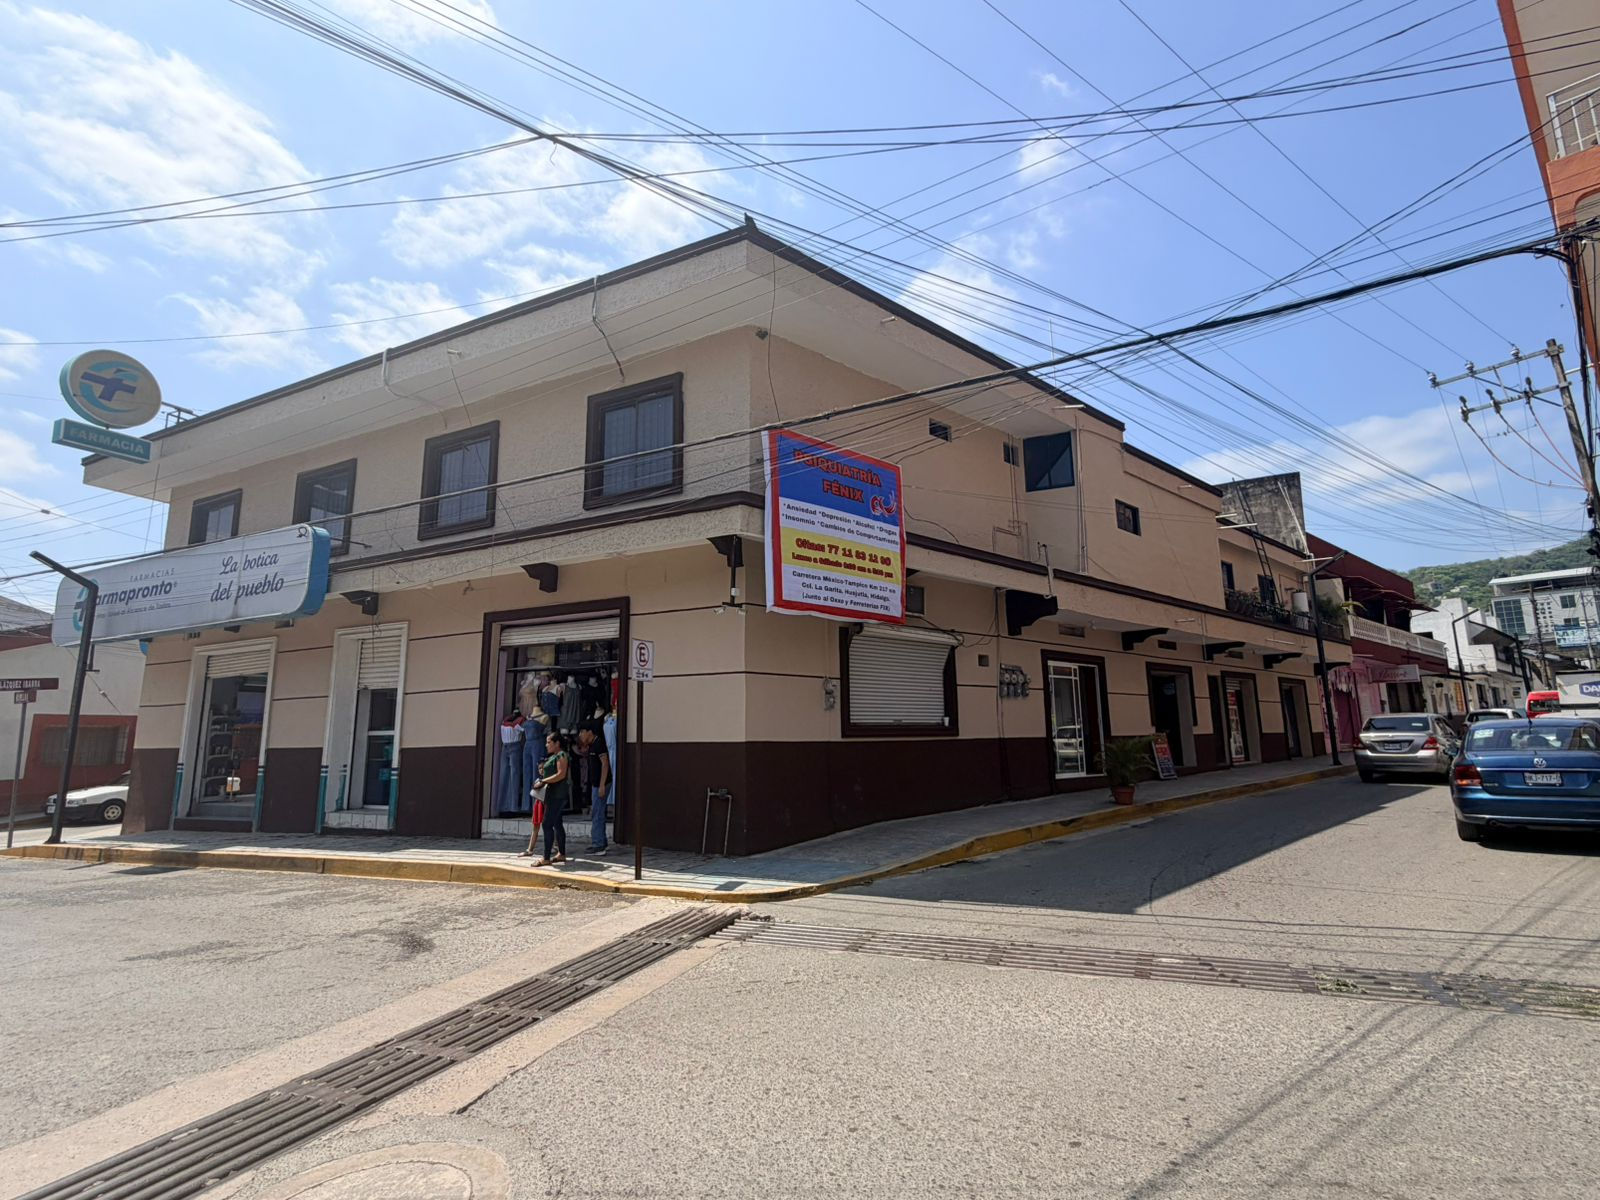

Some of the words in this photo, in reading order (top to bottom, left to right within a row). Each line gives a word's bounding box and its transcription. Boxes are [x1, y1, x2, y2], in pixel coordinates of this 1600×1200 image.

[70, 428, 145, 453] FARMACIA
[822, 479, 865, 503] FÉNIX
[827, 543, 840, 555] 77
[219, 555, 239, 575] La
[243, 551, 279, 571] botica
[130, 568, 176, 582] FARMACIAS
[792, 570, 821, 581] Carretera
[210, 580, 234, 602] del
[234, 571, 285, 606] pueblo
[1583, 685, 1600, 693] DA
